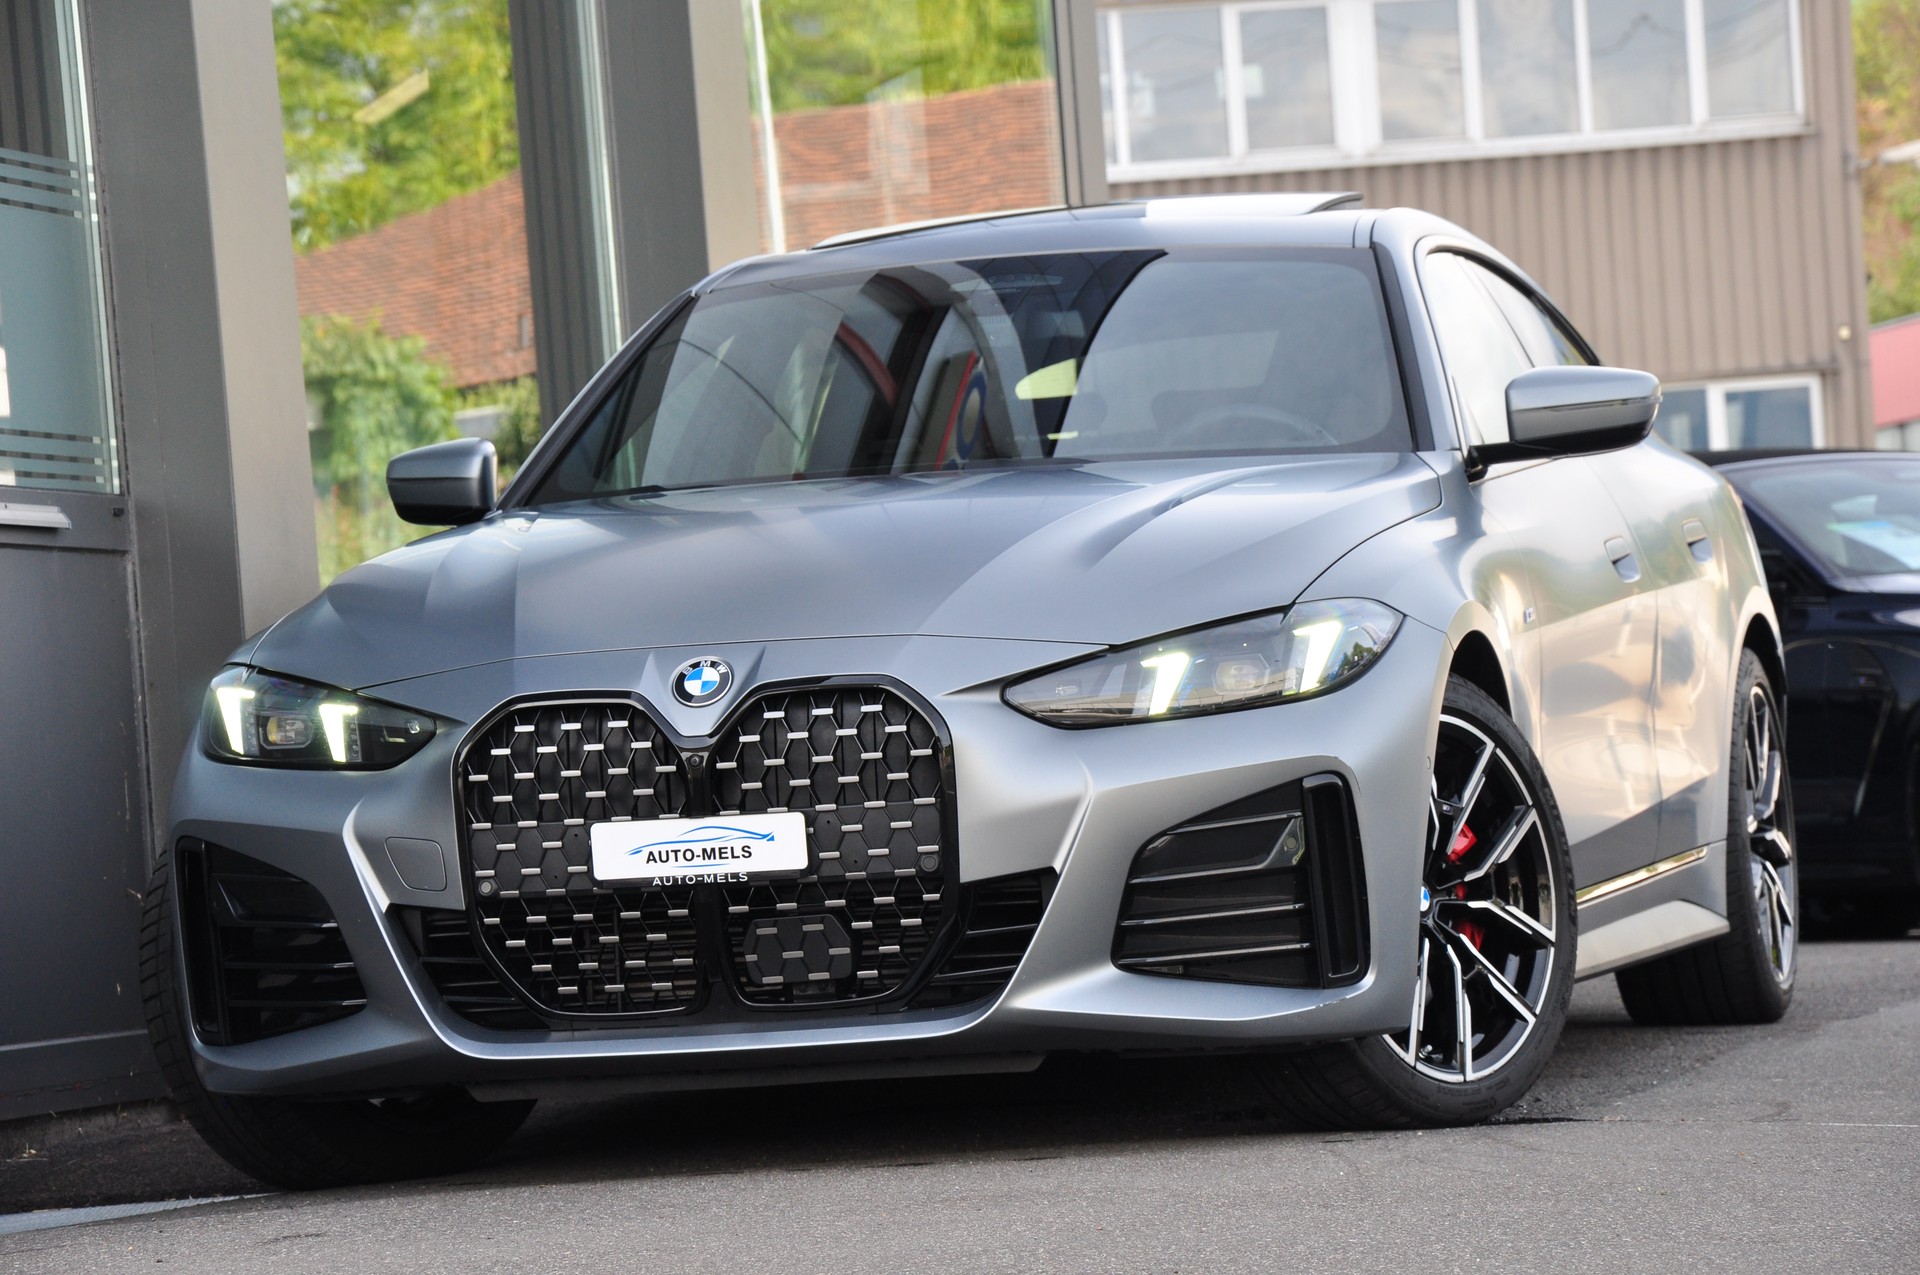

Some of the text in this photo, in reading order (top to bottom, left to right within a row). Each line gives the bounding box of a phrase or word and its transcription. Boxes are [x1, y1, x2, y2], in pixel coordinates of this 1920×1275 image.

[681, 660, 728, 675] BMW
[645, 845, 752, 864] AUTO-MELS
[652, 871, 748, 886] AUTO-MELS
